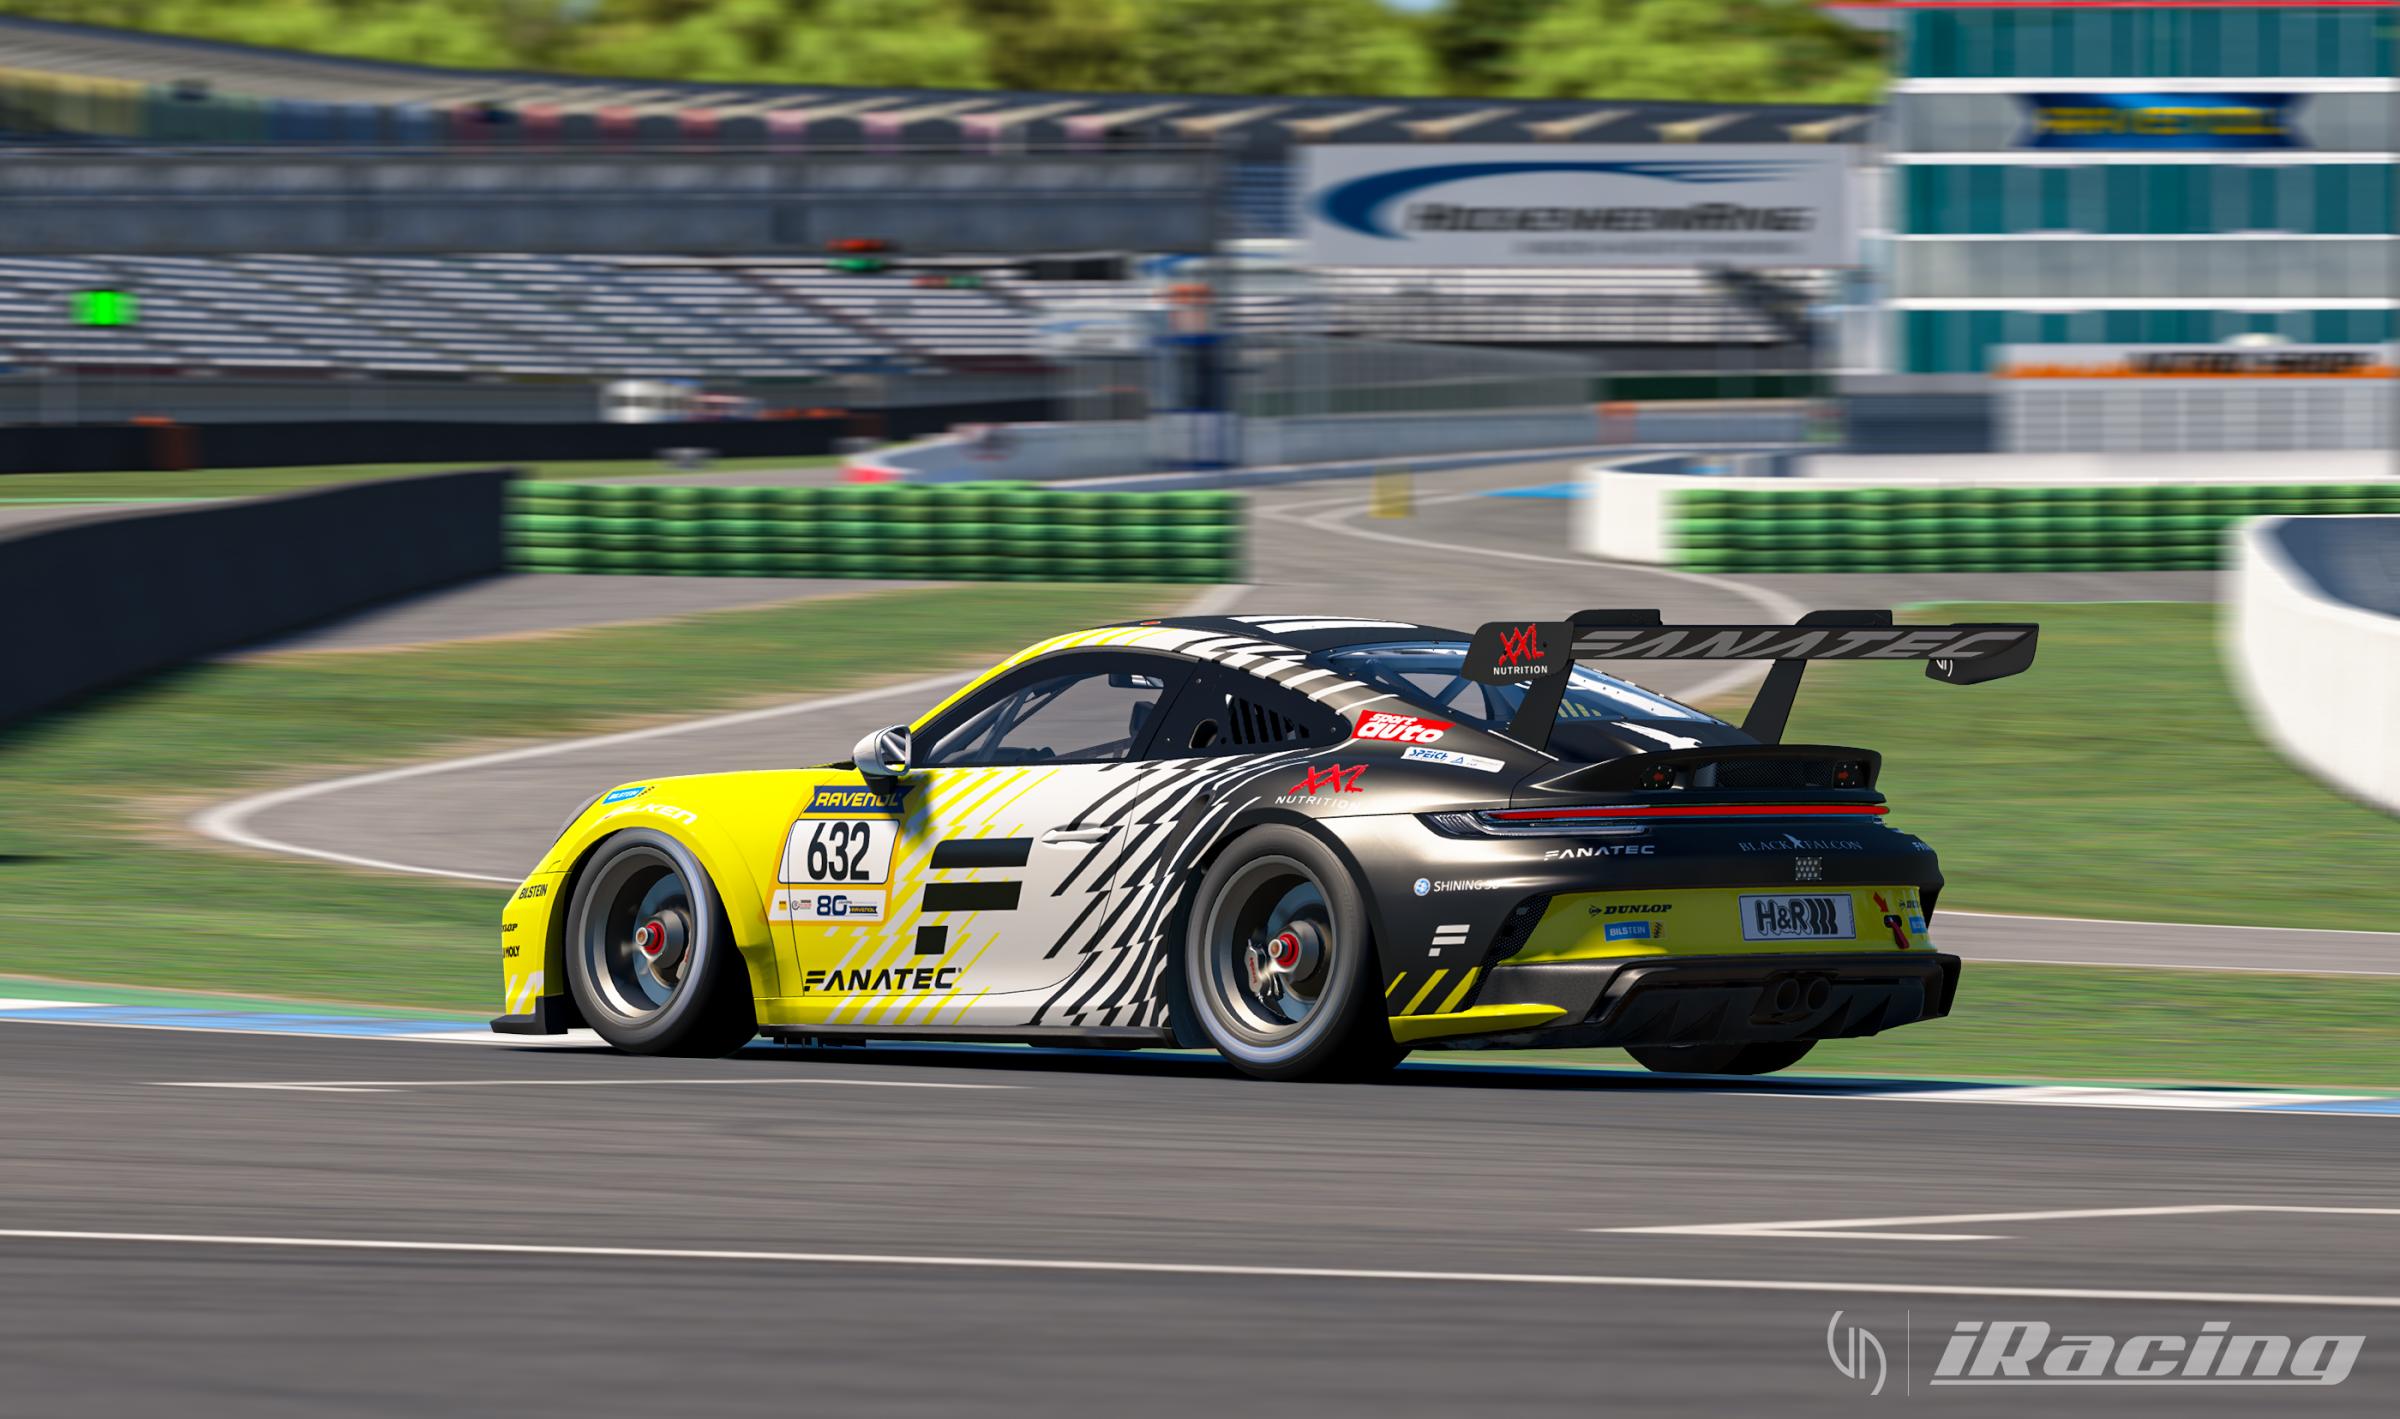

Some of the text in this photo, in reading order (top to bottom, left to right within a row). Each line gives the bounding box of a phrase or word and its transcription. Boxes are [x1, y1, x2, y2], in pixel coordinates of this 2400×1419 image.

[1498, 623, 1545, 666] XXL
[1571, 631, 2026, 659] FANATEC
[1493, 665, 1548, 676] NUTRITION
[1369, 712, 1418, 725] sport
[1357, 721, 1444, 743] auto
[807, 821, 870, 881] 632
[1738, 839, 1789, 852] BLACK
[1802, 839, 1863, 850] FALCON
[1543, 844, 1655, 861] FANATEC
[519, 883, 548, 900] BILSTEIN
[1433, 879, 1484, 892] SHINING
[1603, 904, 1672, 916] DUNLOP
[1609, 926, 1646, 936] BILSTEIN
[803, 967, 957, 992] FANATEC
